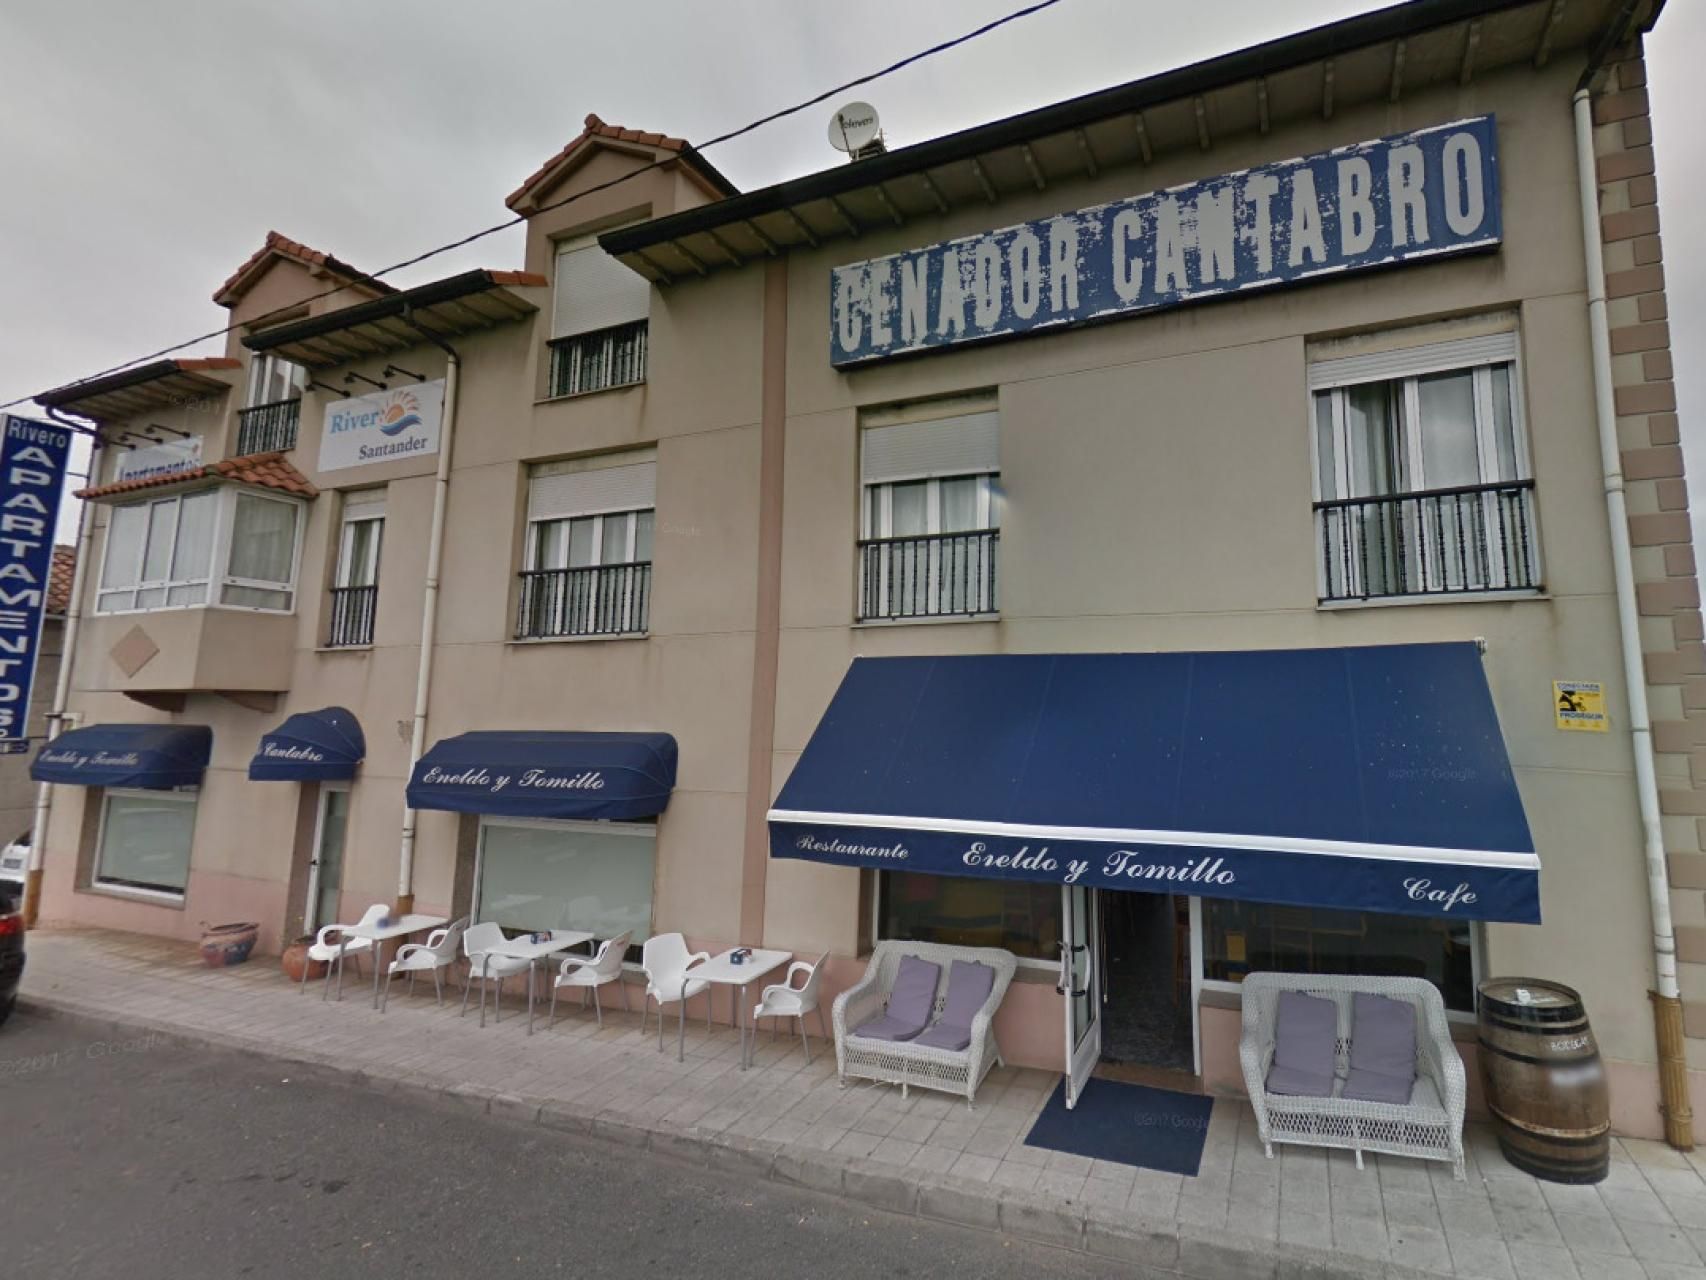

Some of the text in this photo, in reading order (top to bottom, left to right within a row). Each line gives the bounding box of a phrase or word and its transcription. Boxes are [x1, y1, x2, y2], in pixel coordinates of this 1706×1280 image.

[836, 132, 1485, 353] CENADOR CANTABRO
[8, 419, 67, 448] Rivero
[358, 437, 428, 459] Santander
[263, 742, 324, 761] Cantabro
[490, 775, 511, 792] y
[517, 769, 605, 790] Tomillo
[796, 835, 910, 860] Restaurante
[1063, 858, 1089, 883] y
[1102, 850, 1236, 885] Tomillo
[1402, 877, 1478, 911] Cafe
